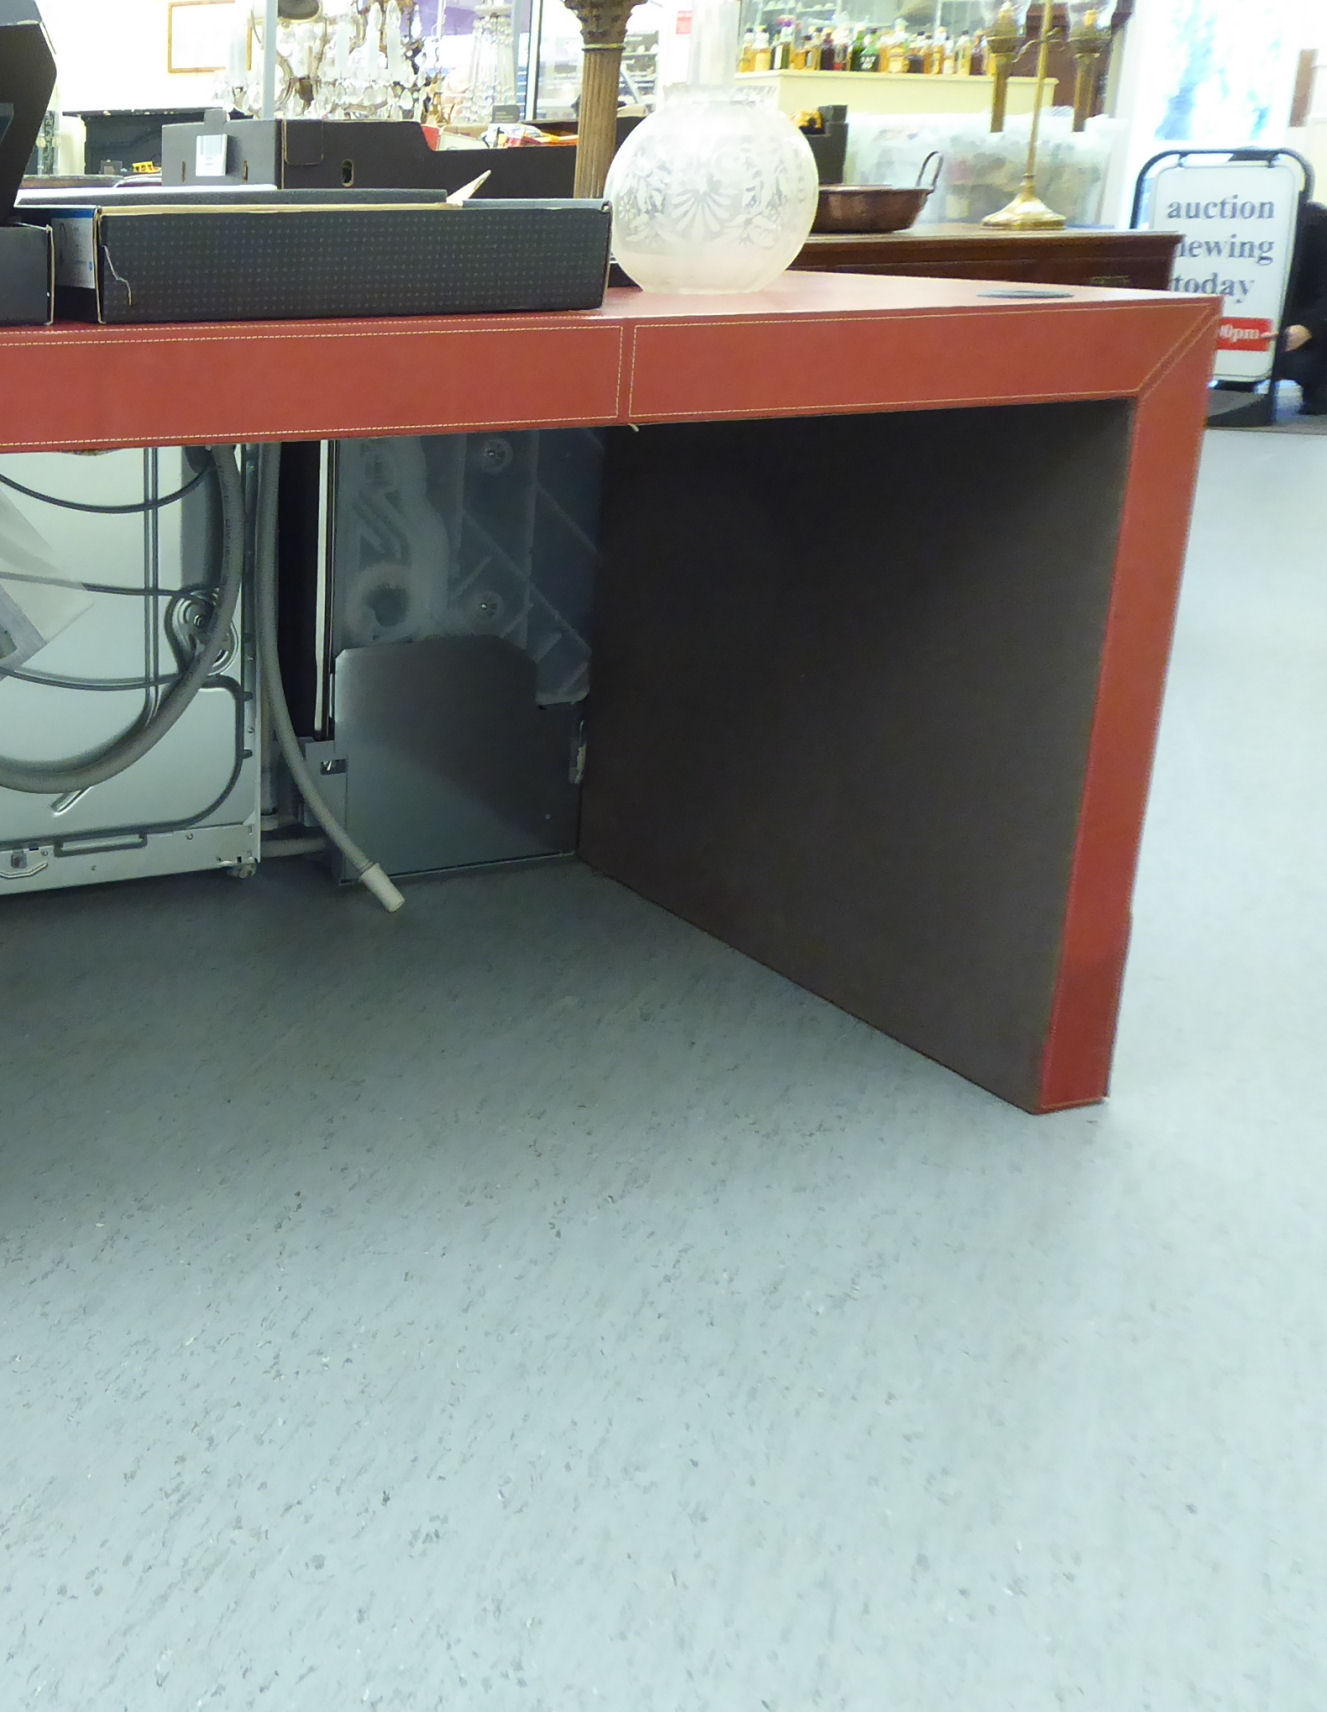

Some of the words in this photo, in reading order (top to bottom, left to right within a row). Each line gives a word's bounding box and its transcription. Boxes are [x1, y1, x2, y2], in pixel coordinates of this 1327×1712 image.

[1167, 194, 1274, 219] auction
[1179, 233, 1274, 266] iewing
[1173, 272, 1254, 304] today
